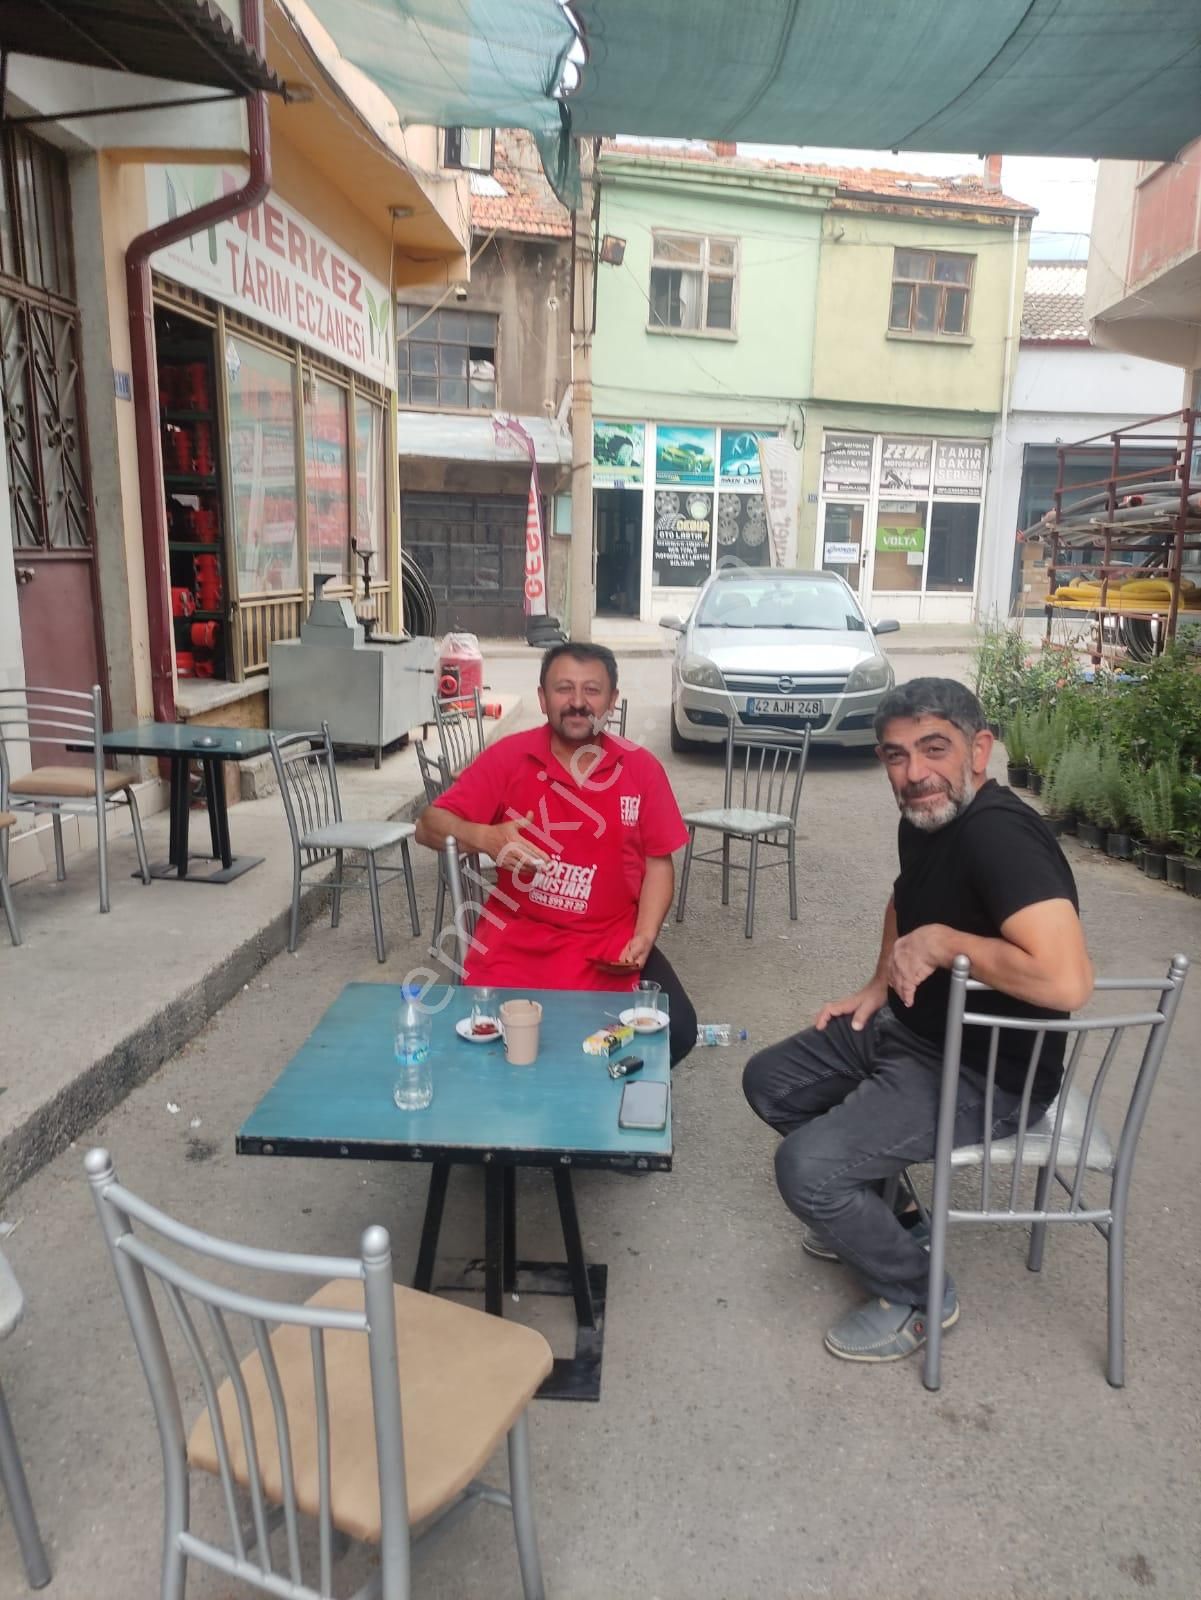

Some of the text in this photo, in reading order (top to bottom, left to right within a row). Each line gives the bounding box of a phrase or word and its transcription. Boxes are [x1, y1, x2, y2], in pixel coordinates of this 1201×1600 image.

[222, 168, 363, 313] MERKEZ
[226, 239, 292, 324] TARIM
[883, 534, 918, 546] VOLTA
[755, 701, 819, 714] 42 AJH 248
[531, 871, 592, 901] MUSTAFA
